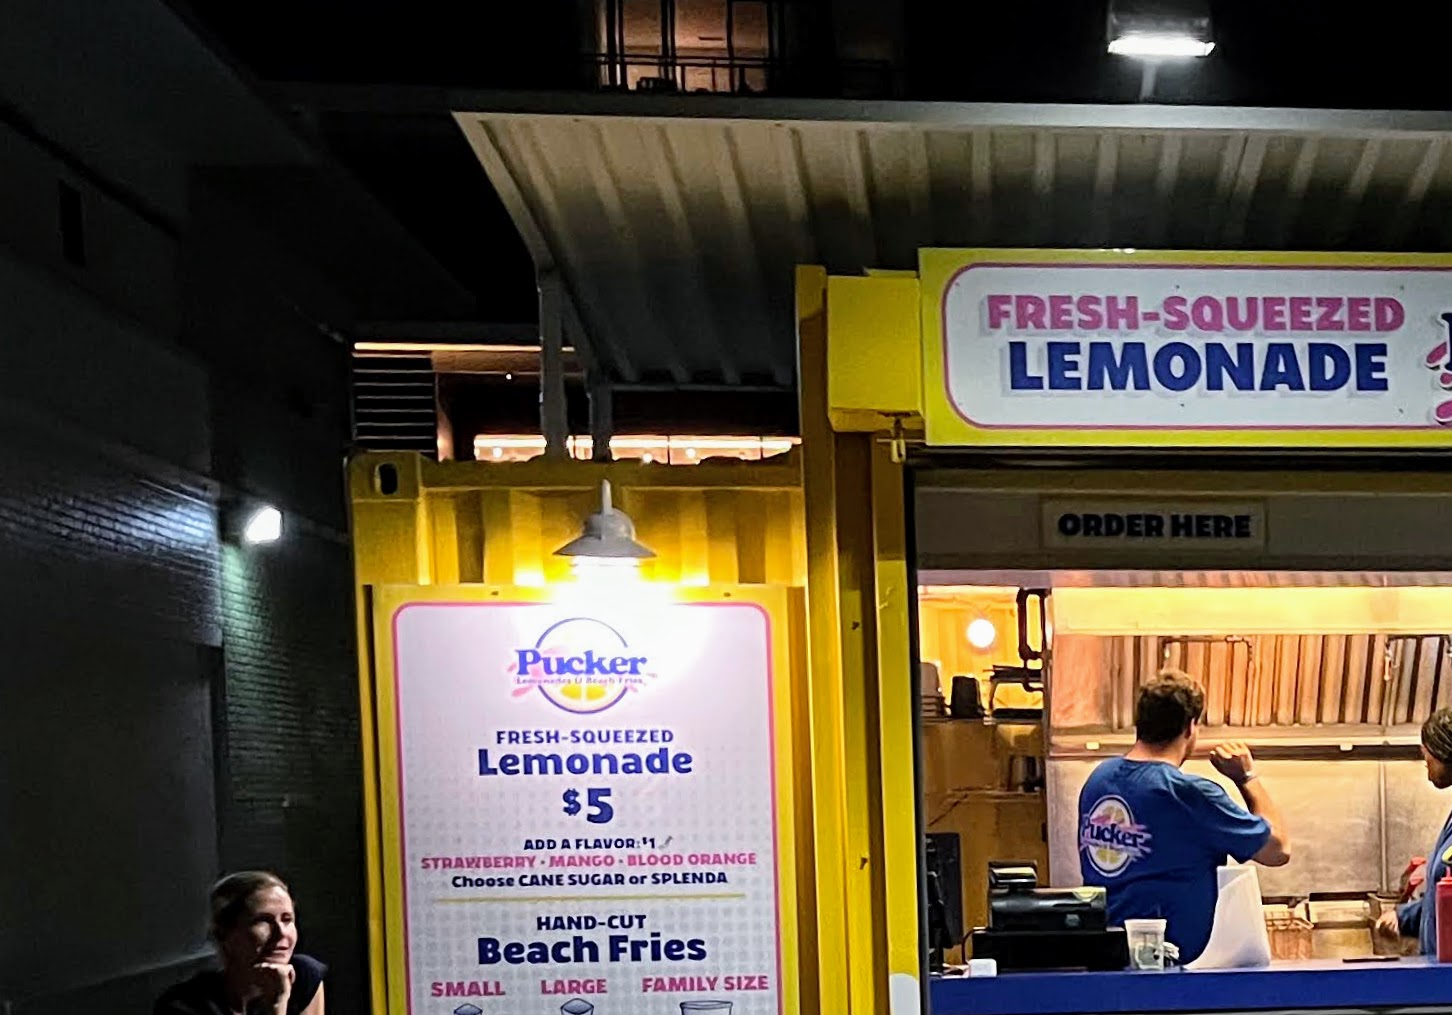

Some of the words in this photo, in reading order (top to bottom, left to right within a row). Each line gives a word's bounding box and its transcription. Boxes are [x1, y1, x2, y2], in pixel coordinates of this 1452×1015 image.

[987, 294, 1405, 332] FRESH-SQUEEZED
[1008, 341, 1389, 391] LEMONADE
[1057, 512, 1164, 538] ORDER
[1171, 512, 1251, 538] HERE
[515, 649, 648, 675] Pucker
[496, 730, 674, 745] FRESH-SQUEEZED
[478, 748, 693, 776] Lemonade
[562, 787, 614, 824] $5
[523, 838, 557, 851] ADD
[561, 838, 572, 850] A
[421, 856, 537, 870] STRAWBERRY
[549, 855, 615, 868] MANGO
[627, 853, 683, 867] BLOOD
[688, 852, 757, 866] ORANGE
[452, 874, 515, 888] Choose
[518, 874, 565, 887] CANE
[568, 873, 626, 886] SUGAR
[628, 874, 648, 886] or
[651, 872, 728, 885] SPLENDA
[537, 915, 647, 931] HAND-CUT
[477, 935, 600, 965] Beach
[609, 932, 707, 963] Fries
[431, 981, 506, 997] SMALL
[541, 979, 608, 995] LARGE
[641, 976, 718, 993] FAMILY
[724, 975, 769, 991] SIZE
